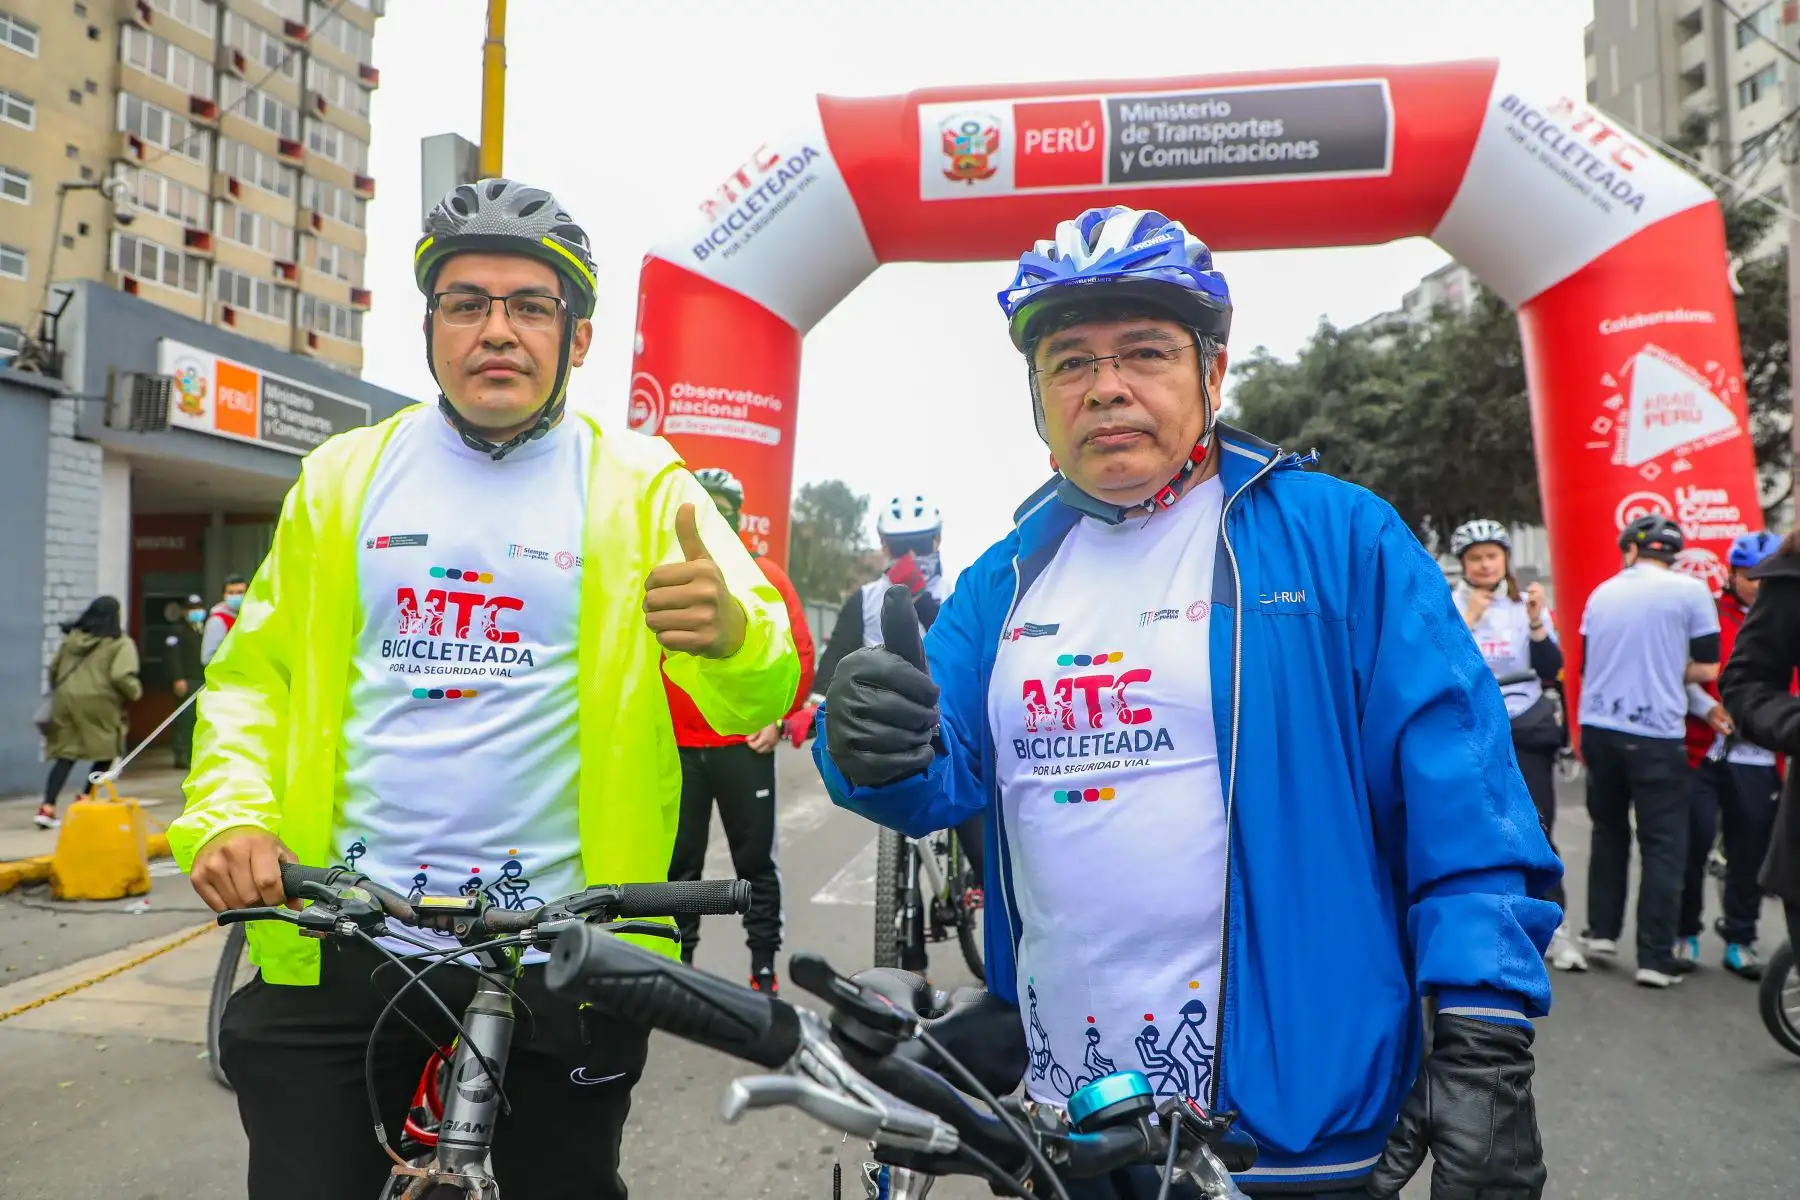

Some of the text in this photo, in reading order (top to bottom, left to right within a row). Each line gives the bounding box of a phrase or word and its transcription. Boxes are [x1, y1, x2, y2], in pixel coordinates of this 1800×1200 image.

[1119, 99, 1231, 123] Ministerio
[1024, 120, 1096, 154] PERÚ
[1120, 118, 1284, 145] de Transportes
[1120, 139, 1320, 173] y Comunicaciones
[1500, 94, 1646, 214] BICICLETEADA
[693, 145, 820, 261] BICICLETEADA
[1132, 233, 1175, 251] PROWELL
[218, 386, 255, 413] PERÚ
[264, 383, 314, 411] Ministerio
[669, 399, 749, 419] Nacional
[670, 381, 783, 412] Observatorio
[279, 405, 333, 432] Transportes
[1675, 484, 1729, 504] Lima
[524, 547, 549, 557] Siempre
[397, 588, 525, 644] MTC
[382, 639, 534, 667] BICICLETEADA
[389, 664, 513, 677] POR LA SEGURIDAD VIAL
[1023, 669, 1152, 732] MTC
[1013, 728, 1174, 759] BICICLETEADA
[1033, 759, 1150, 776] POR LA SEGURIDAD VIAL
[444, 1120, 492, 1136] GIANT
